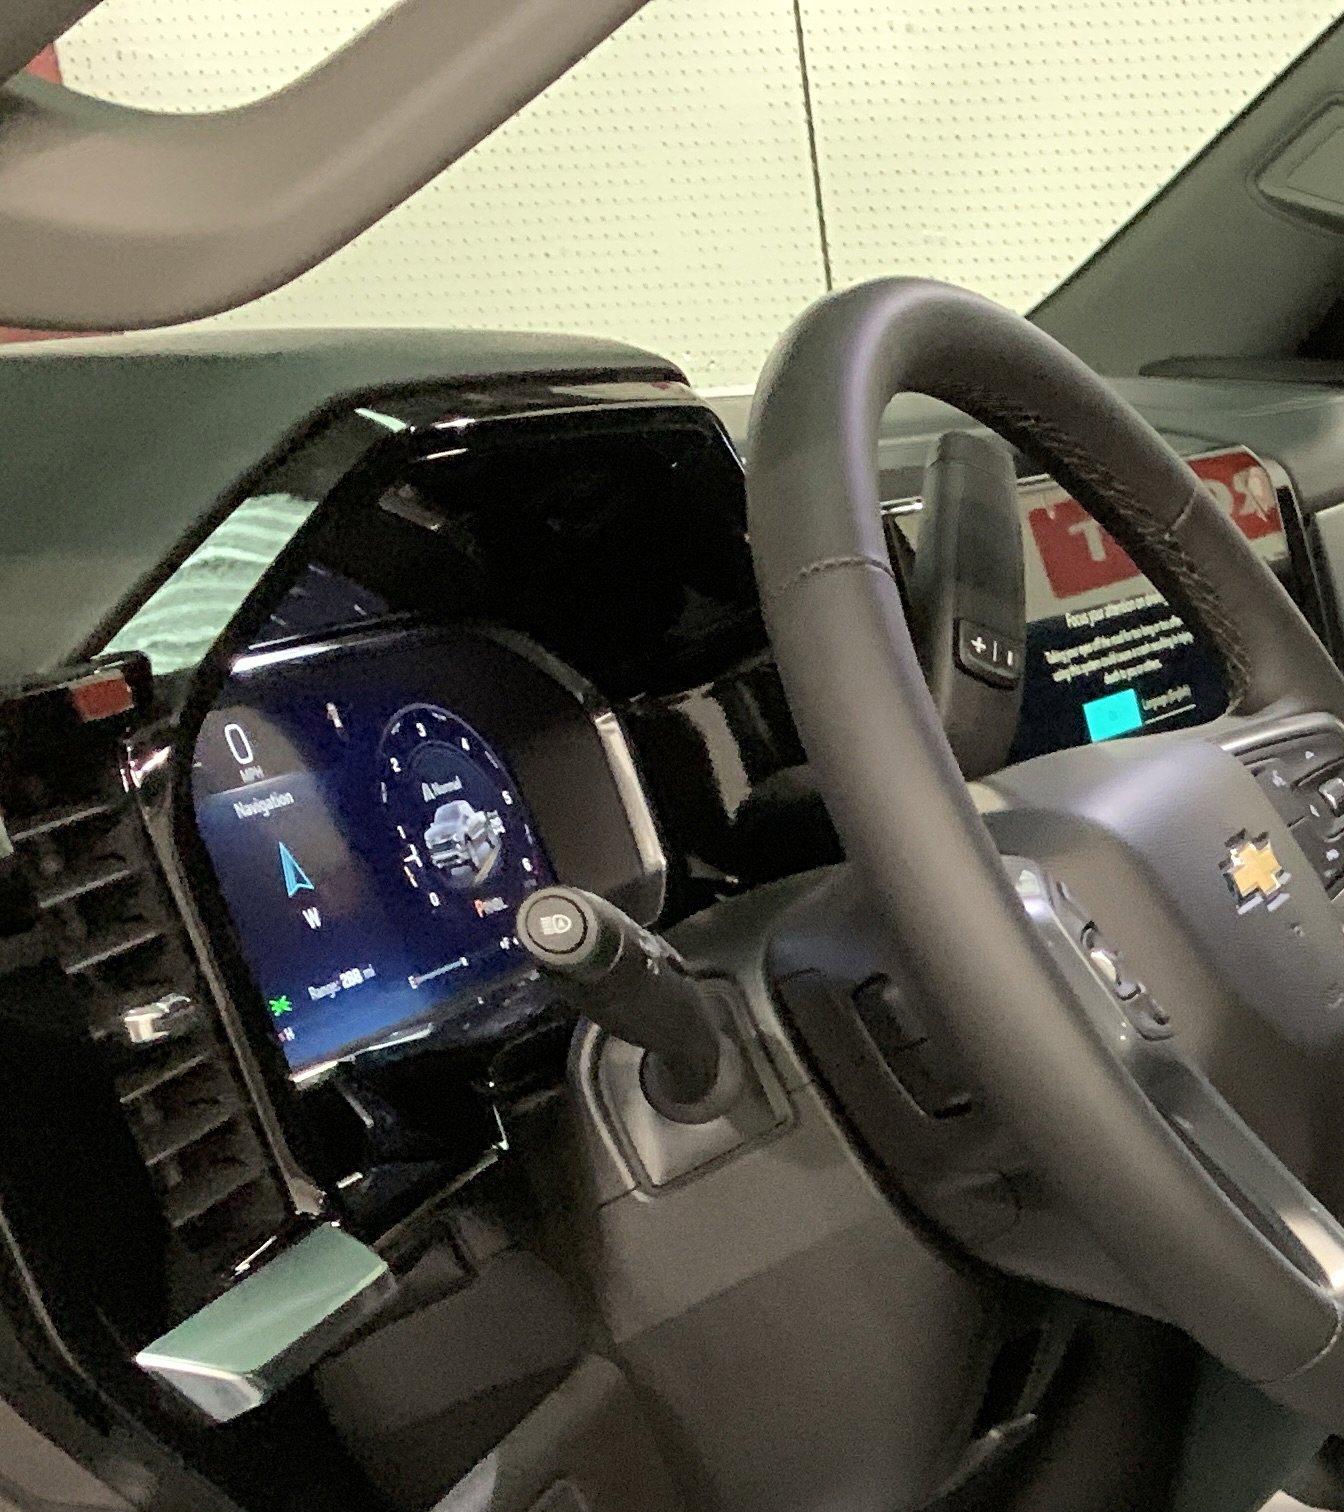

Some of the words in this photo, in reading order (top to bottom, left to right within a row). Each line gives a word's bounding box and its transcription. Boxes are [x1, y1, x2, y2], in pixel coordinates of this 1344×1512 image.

[224, 723, 254, 764] 0
[233, 792, 294, 819] Navigation
[302, 906, 321, 929] W
